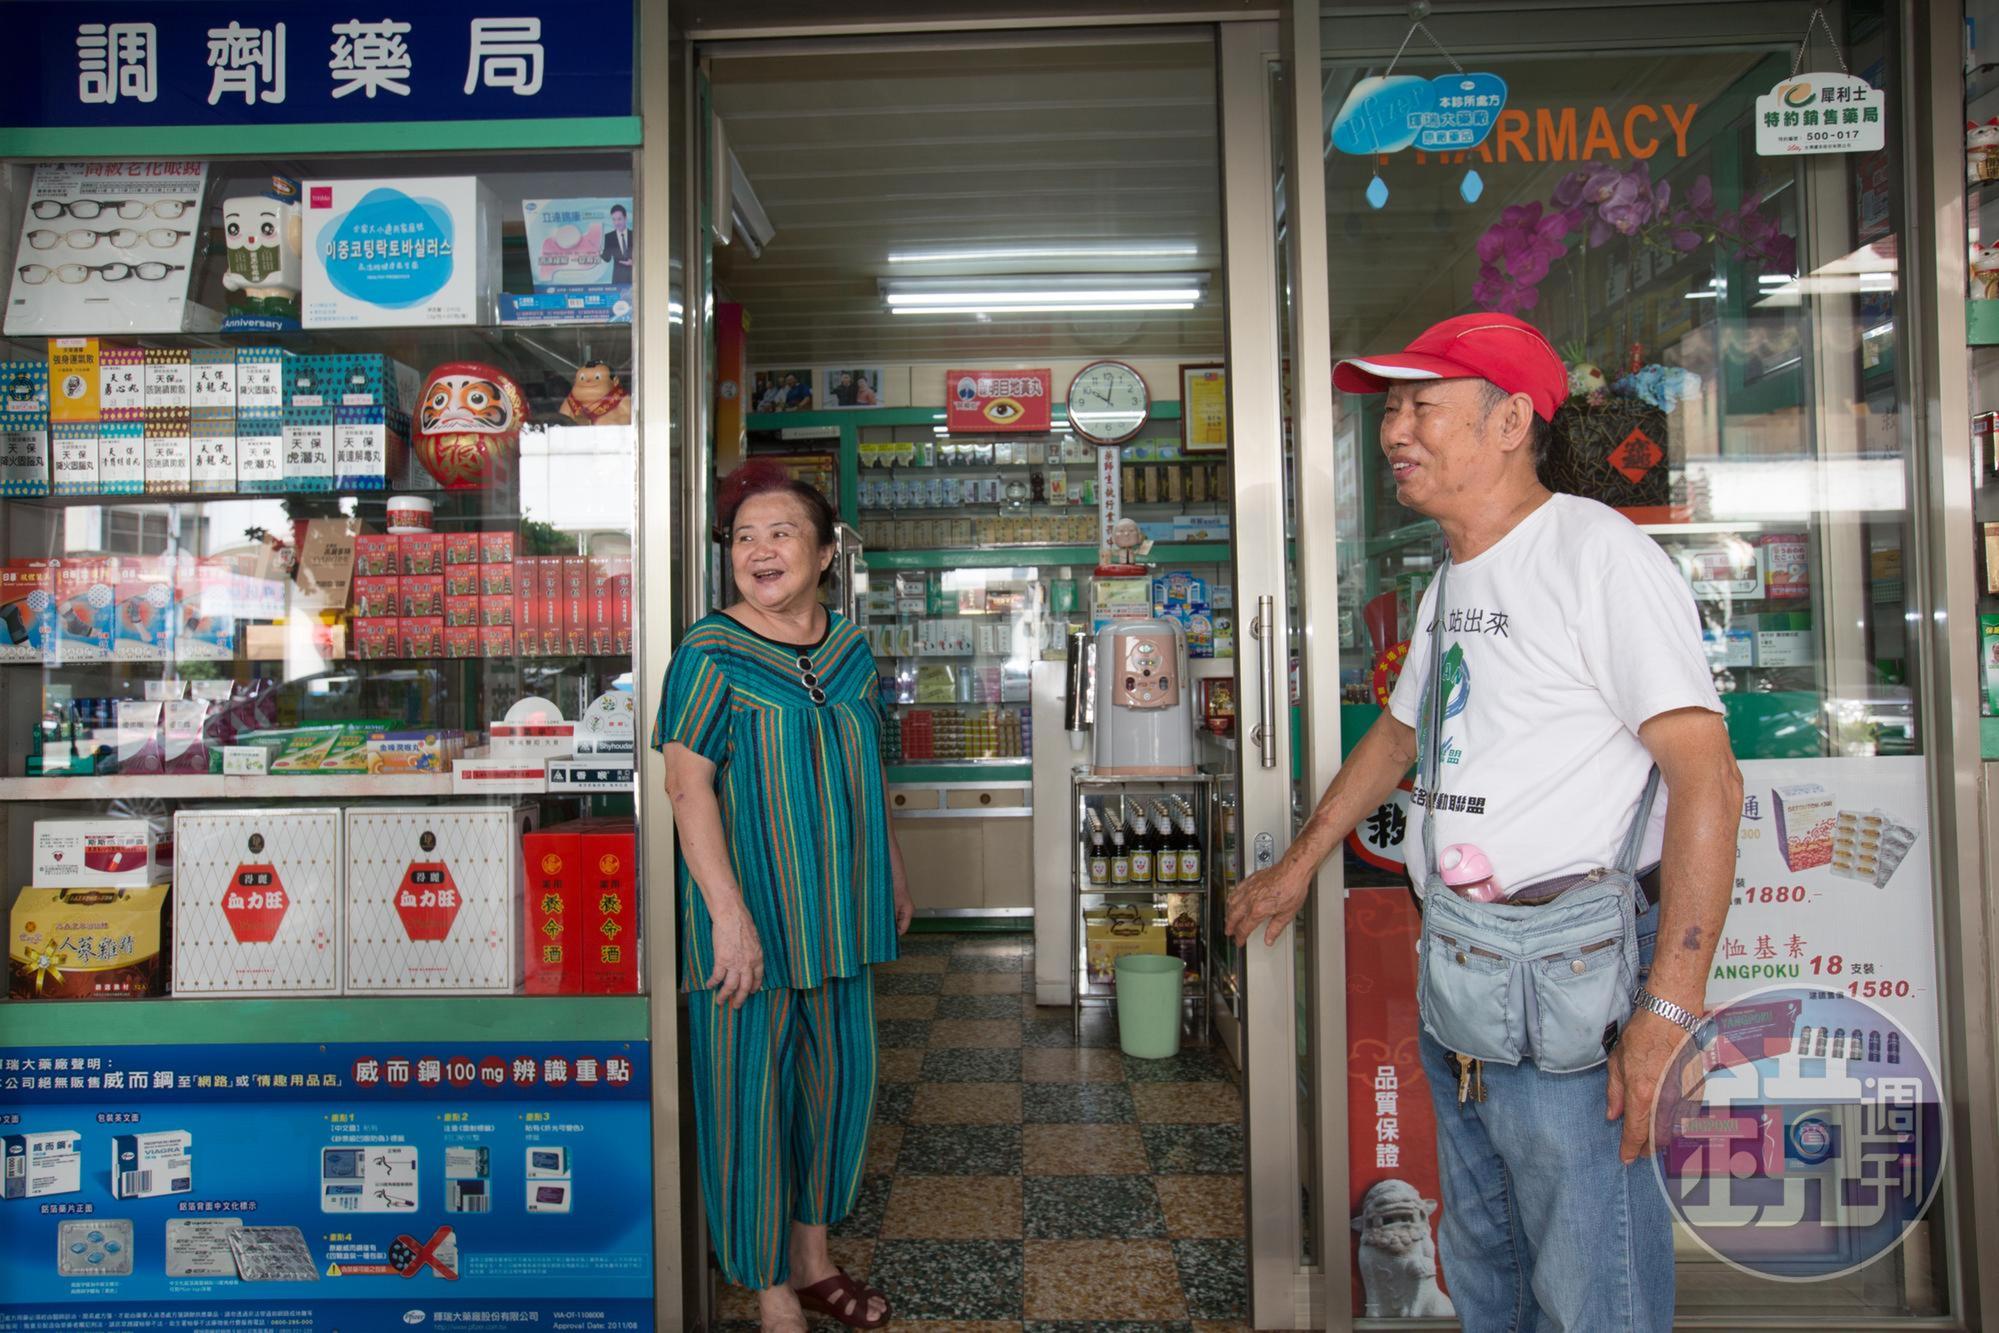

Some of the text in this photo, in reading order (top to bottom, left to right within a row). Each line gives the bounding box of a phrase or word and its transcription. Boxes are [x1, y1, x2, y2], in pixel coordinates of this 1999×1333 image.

[76, 17, 545, 105] 調劑藥局
[1820, 86, 1867, 103] 犀利士
[1764, 107, 1879, 128] 特約銷售藥局
[1806, 130, 1860, 141] 500-017
[325, 238, 453, 260] 이중코팅락토바실러스
[224, 317, 283, 331] Anniversary
[227, 891, 283, 910] 血力旺
[400, 889, 456, 908] 血力旺
[541, 892, 564, 964] 養命酒
[599, 892, 622, 964] 養命酒
[1809, 955, 1875, 976] 18 支裝
[0, 1058, 112, 1070] 瑞大藥廠聲明：
[0, 1115, 19, 1124] 文面
[1374, 1065, 1400, 1169] 品質保證
